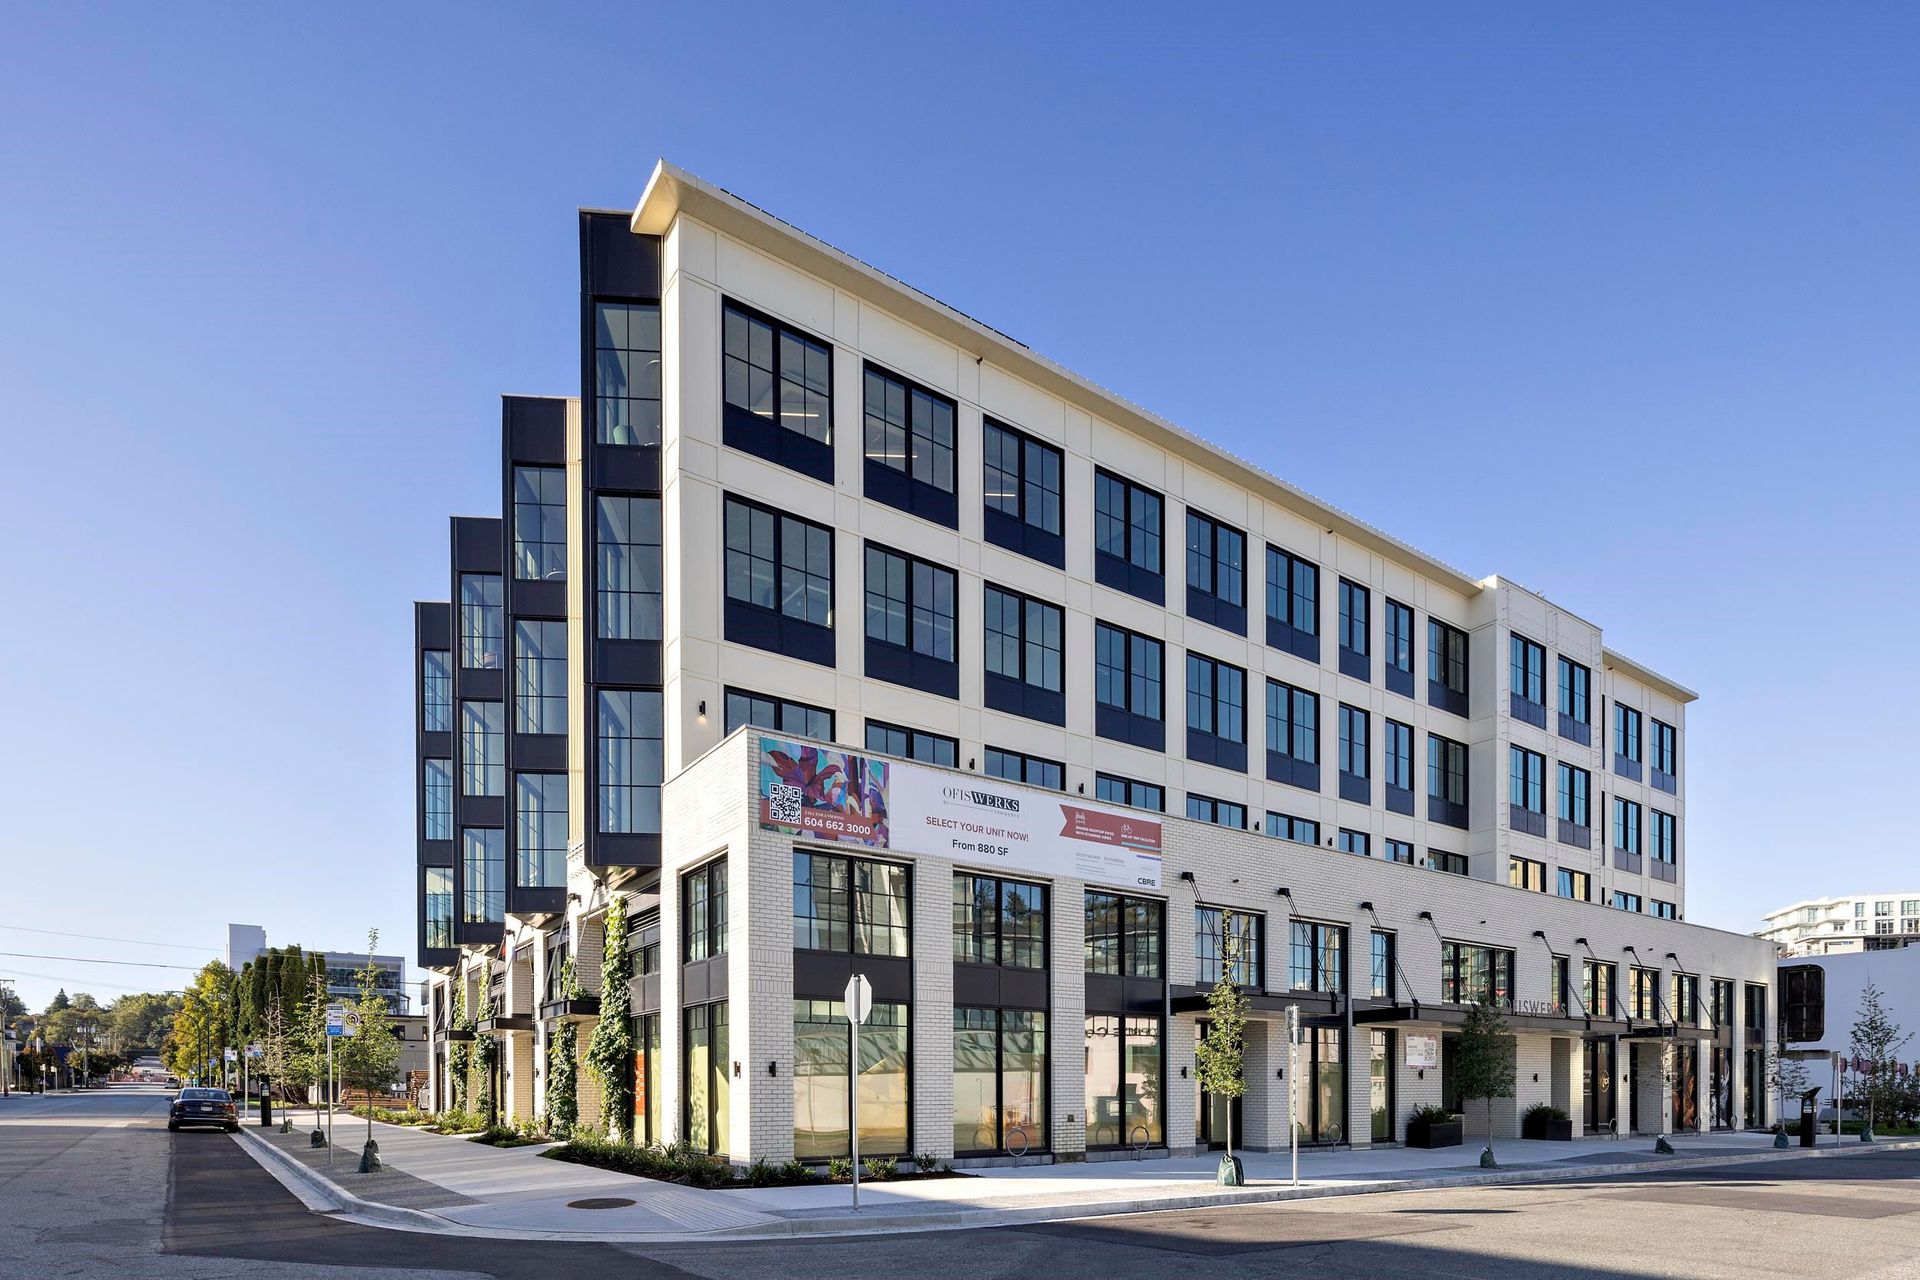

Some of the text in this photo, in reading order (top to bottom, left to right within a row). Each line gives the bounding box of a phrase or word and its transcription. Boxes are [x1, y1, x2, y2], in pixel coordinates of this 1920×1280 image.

[943, 786, 1019, 812] OFISWERKS
[804, 817, 871, 835] 604 662 3000
[926, 816, 1029, 842] SELECT YOUR UNIT NOW!
[952, 839, 1009, 857] From 880 SF
[1137, 877, 1156, 887] CBRE
